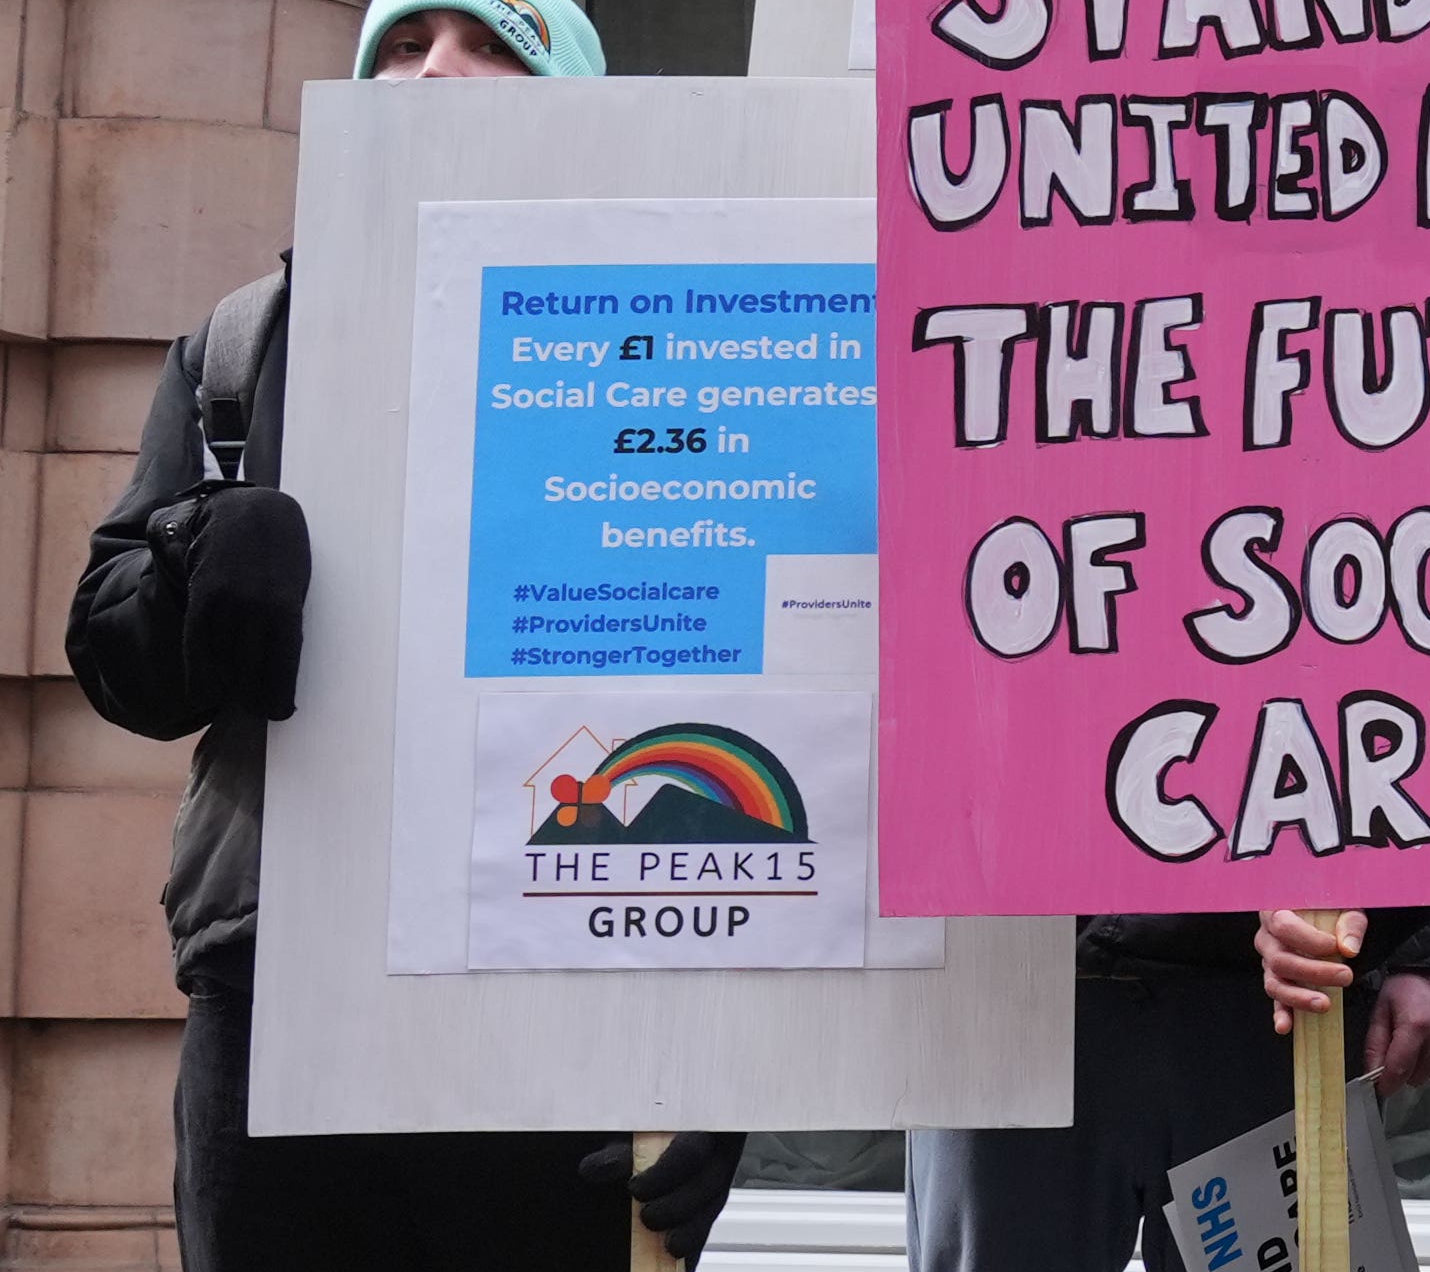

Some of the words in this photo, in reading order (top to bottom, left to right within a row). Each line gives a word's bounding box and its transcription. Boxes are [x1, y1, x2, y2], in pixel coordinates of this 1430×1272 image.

[500, 19, 537, 56] GROUP
[907, 86, 1388, 232] UNITED
[502, 291, 619, 315] Return
[630, 294, 673, 314] on
[685, 289, 876, 314] Investmen
[512, 336, 610, 367] Every
[619, 335, 655, 360] £1
[665, 333, 818, 360] invested
[829, 331, 862, 360] in
[912, 292, 1208, 448] THE
[490, 380, 595, 409] Social
[606, 381, 687, 408] Care
[697, 381, 877, 413] generates
[613, 428, 708, 454] £2.36
[717, 426, 749, 453] in
[544, 472, 817, 502] Socioeconomic
[601, 520, 757, 548] benefits.
[513, 582, 720, 603] #ValueSocialcare
[964, 510, 1146, 662] OF
[781, 599, 872, 609] #ProvidersUnite
[511, 614, 707, 635] #ProvidersUnite
[510, 645, 742, 668] #StrongerTogether
[525, 852, 610, 882] THE
[639, 851, 816, 882] PEAK15
[588, 905, 750, 939] GROUP
[1191, 1176, 1243, 1272] NHS
